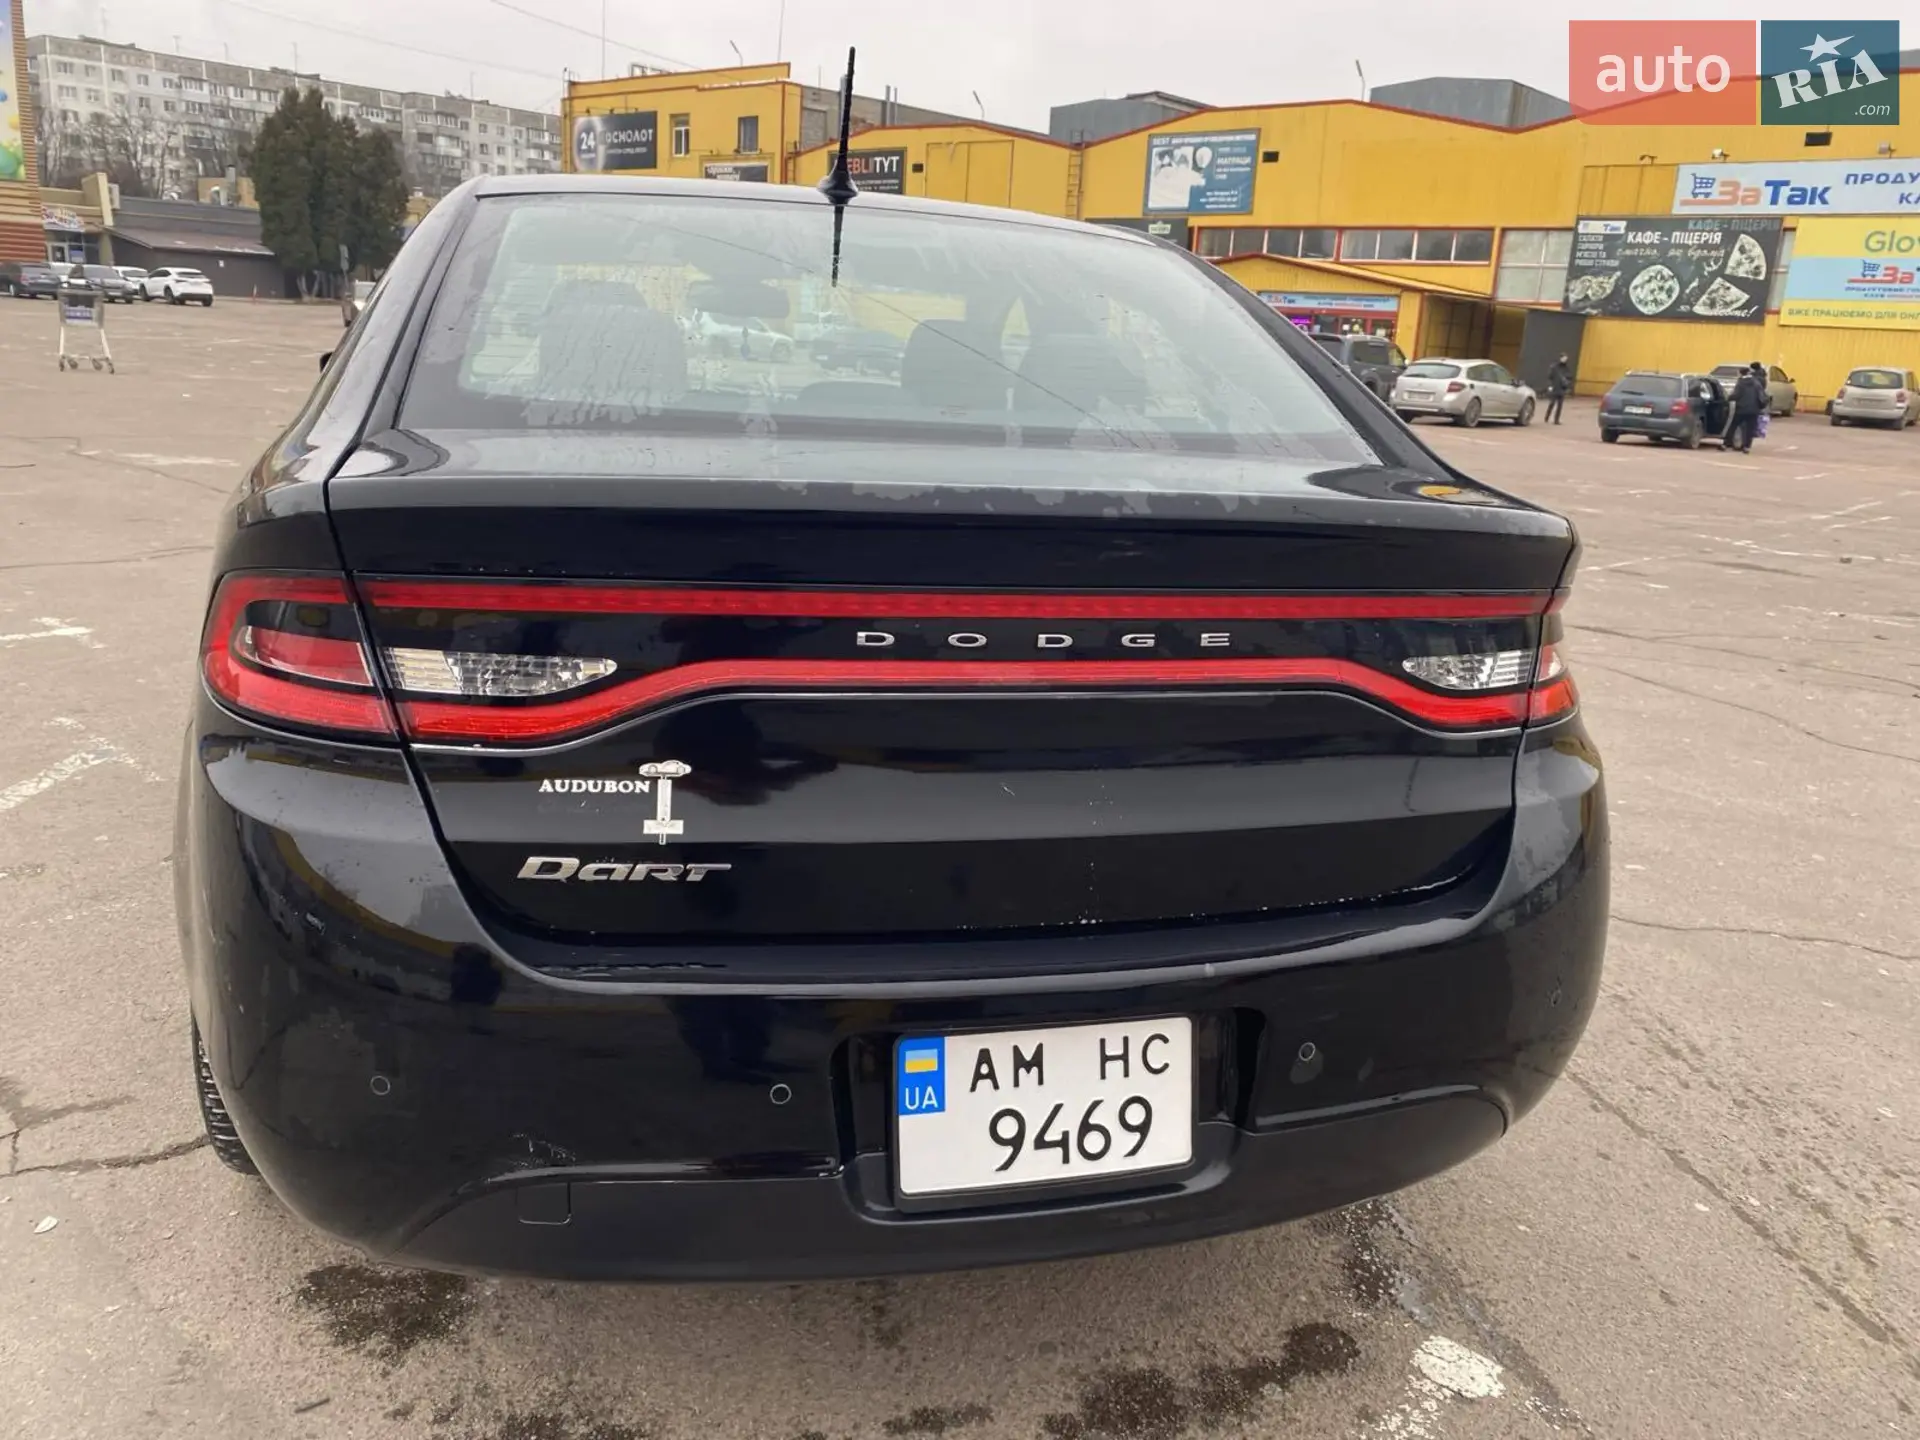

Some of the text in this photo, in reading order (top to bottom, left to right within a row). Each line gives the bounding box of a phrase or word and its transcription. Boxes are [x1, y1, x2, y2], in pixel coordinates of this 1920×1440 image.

[580, 131, 596, 150] 24
[1845, 172, 1920, 185] ПРОДУ
[1626, 231, 1662, 245] КАФЕ
[1670, 231, 1723, 245] ПІЦЕРІЯ
[1864, 229, 1920, 254] Glo
[1882, 266, 1920, 284] За
[856, 631, 1231, 648] DODGE
[538, 779, 650, 794] AUDUBON
[969, 1033, 1171, 1093] AM HC
[905, 1085, 938, 1110] UA
[988, 1094, 1153, 1172] 9469
